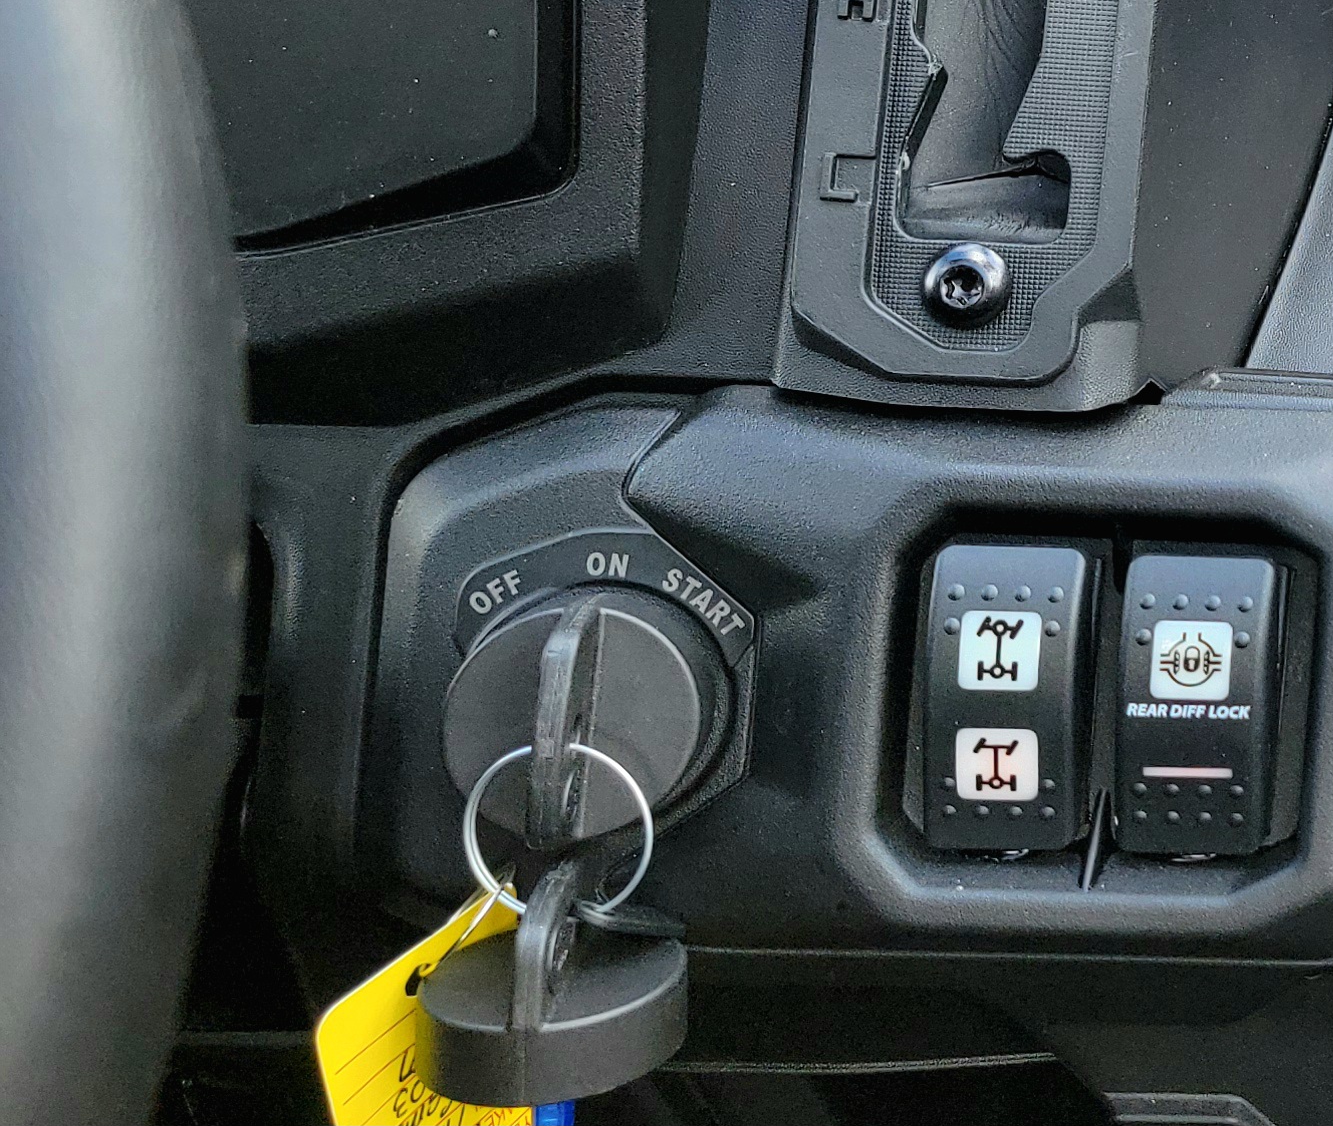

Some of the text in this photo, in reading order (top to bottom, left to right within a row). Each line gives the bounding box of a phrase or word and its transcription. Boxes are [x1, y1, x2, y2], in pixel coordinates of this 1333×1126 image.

[819, 152, 859, 202] L
[468, 551, 747, 636] OFF ON START
[1126, 701, 1251, 721] REAR DIFF LOCK
